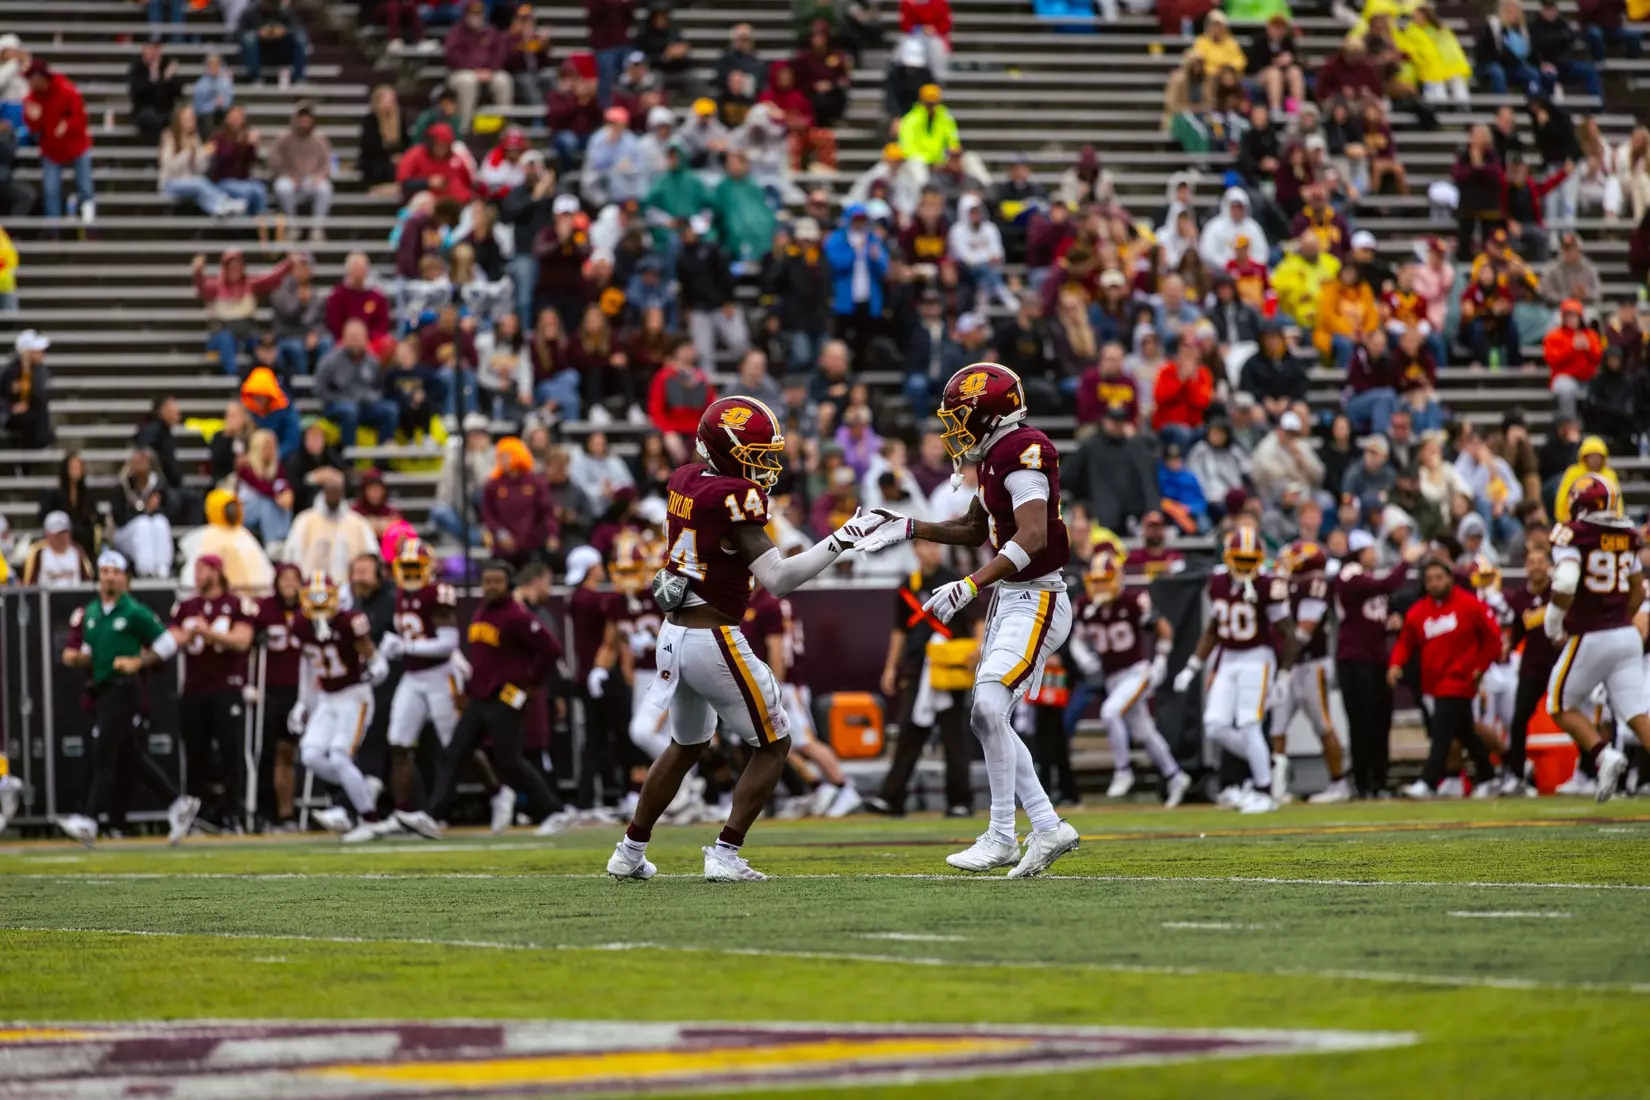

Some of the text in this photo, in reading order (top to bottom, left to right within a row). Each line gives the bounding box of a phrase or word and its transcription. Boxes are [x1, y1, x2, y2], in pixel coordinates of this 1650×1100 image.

[1019, 443, 1043, 469] 4
[668, 490, 694, 520] TAYLOR
[724, 488, 766, 522] 14
